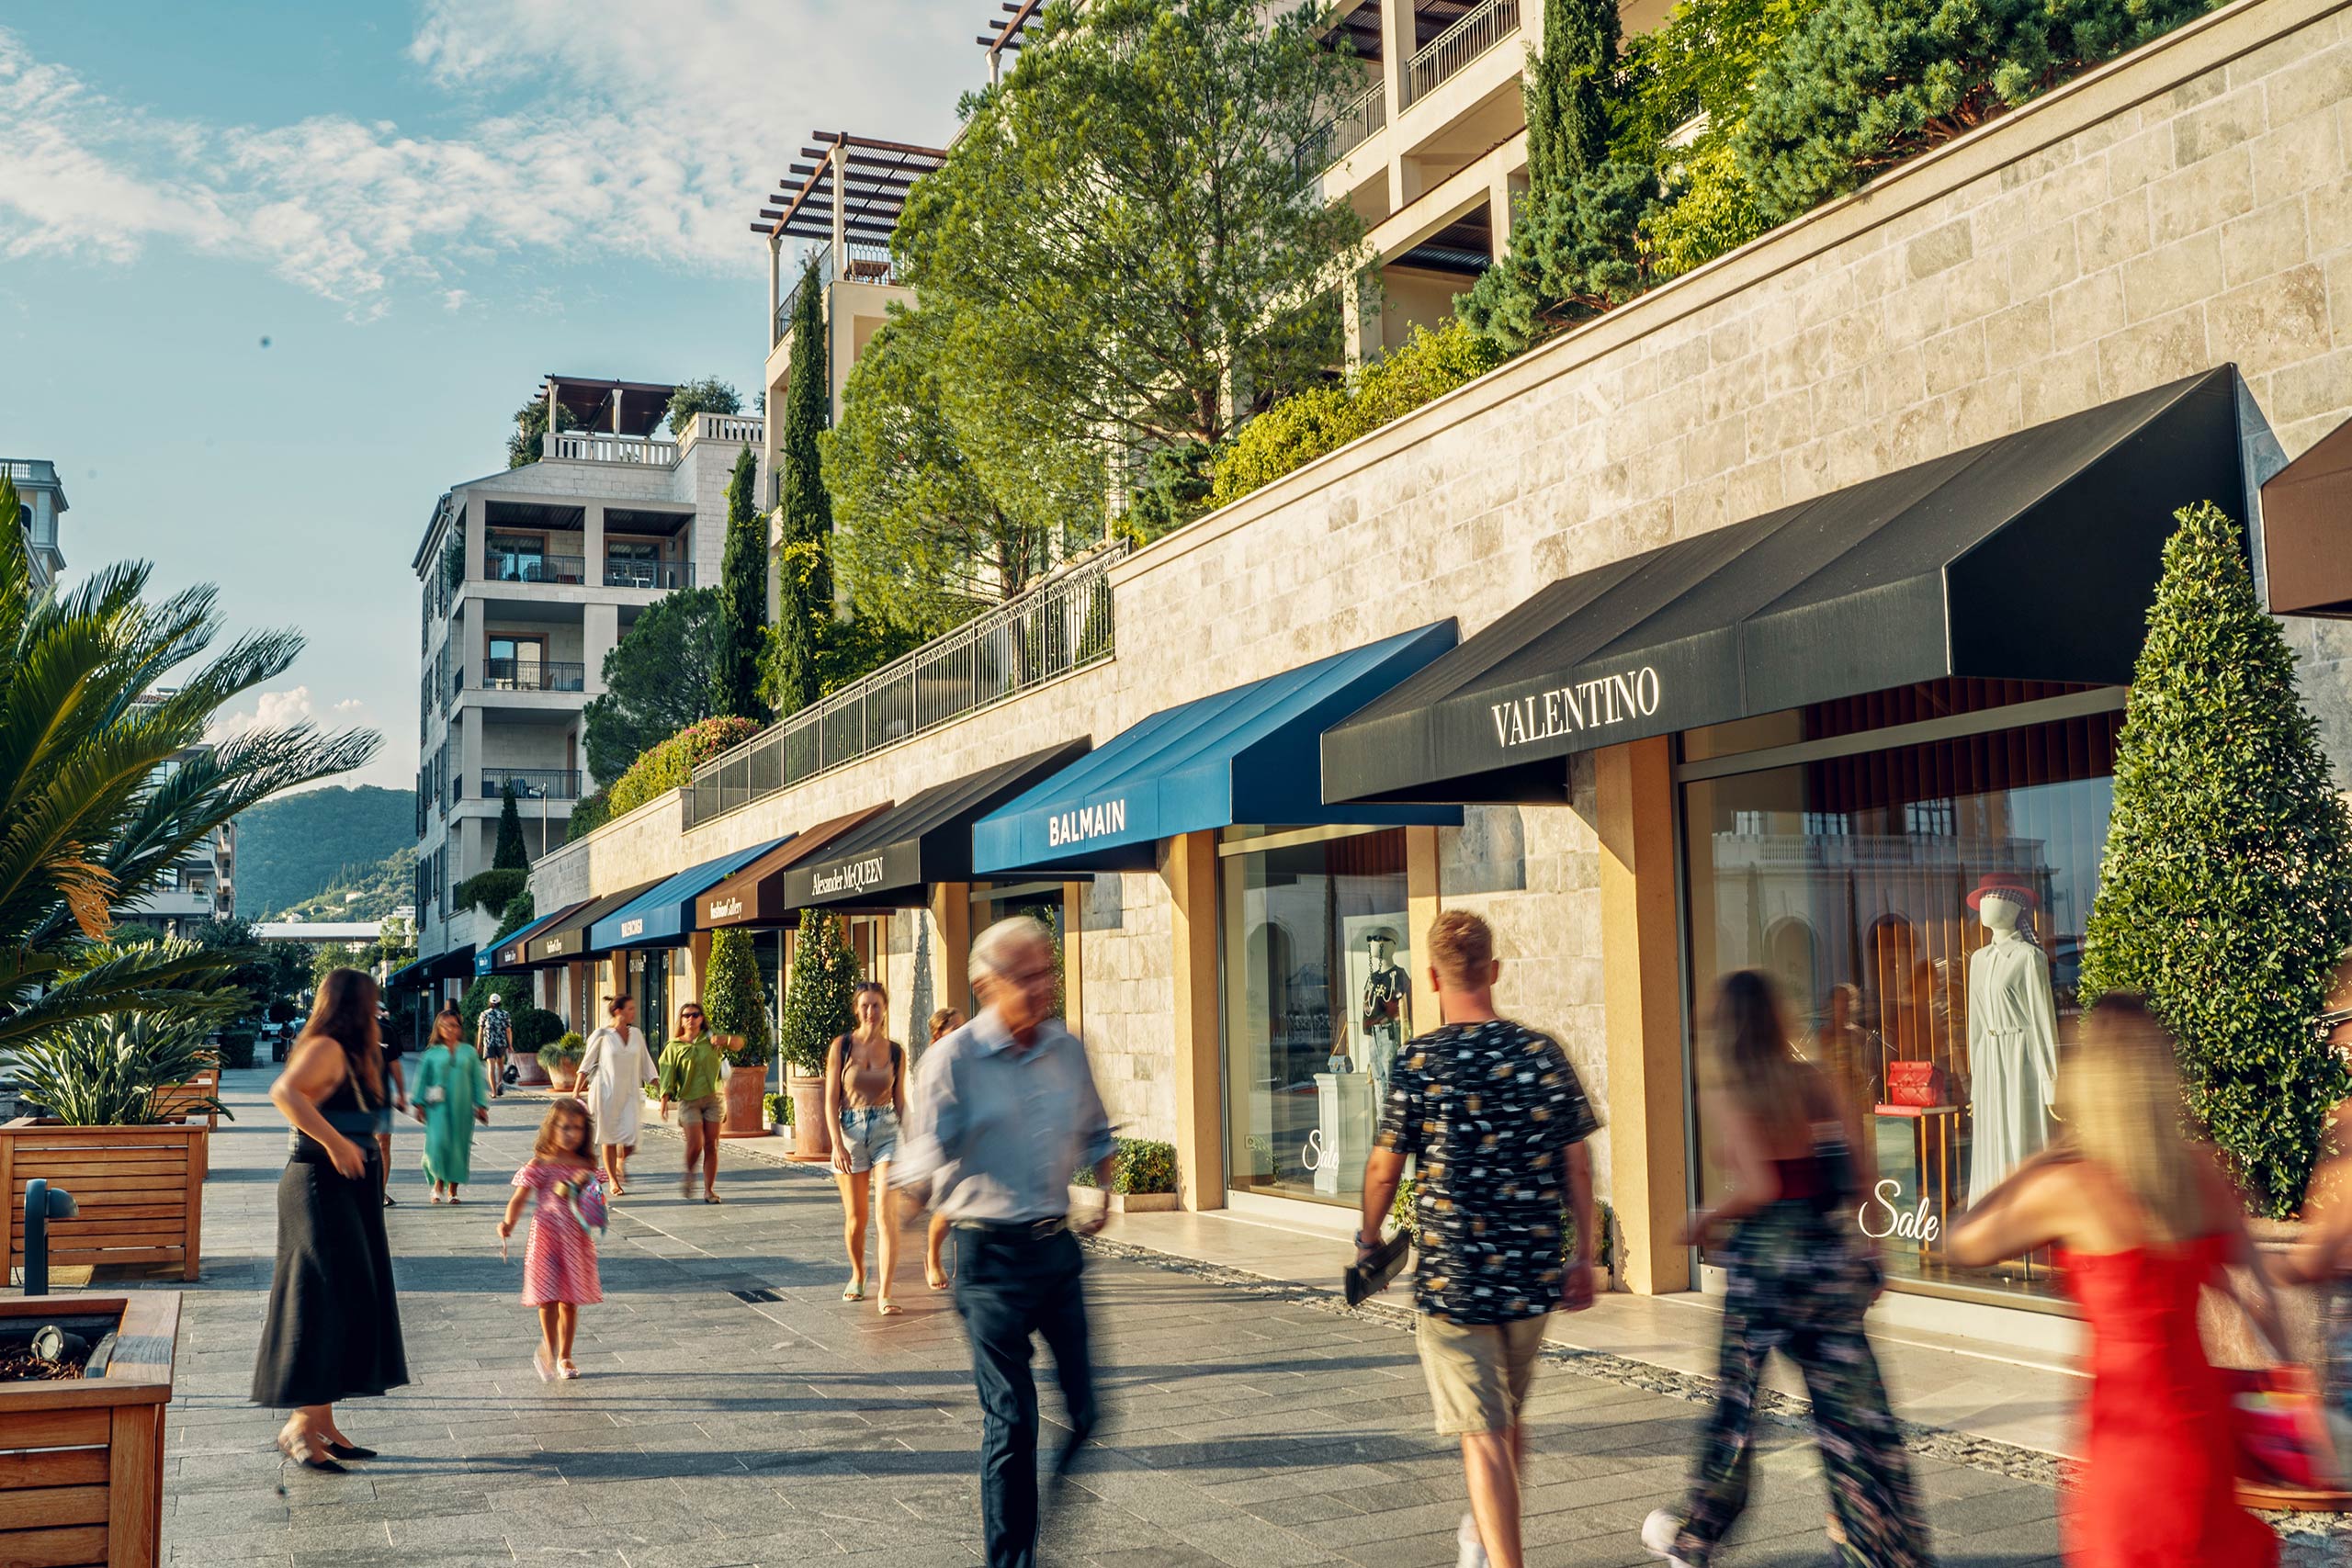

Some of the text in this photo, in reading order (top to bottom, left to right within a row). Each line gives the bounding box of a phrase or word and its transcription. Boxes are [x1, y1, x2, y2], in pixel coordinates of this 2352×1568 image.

[1490, 666, 1659, 748] VALENTINO
[1049, 798, 1125, 847] BALMAIN
[811, 856, 883, 896] Alexander McQUEEN
[1302, 1129, 1340, 1170] Sale
[1858, 1179, 1939, 1242] Sale
